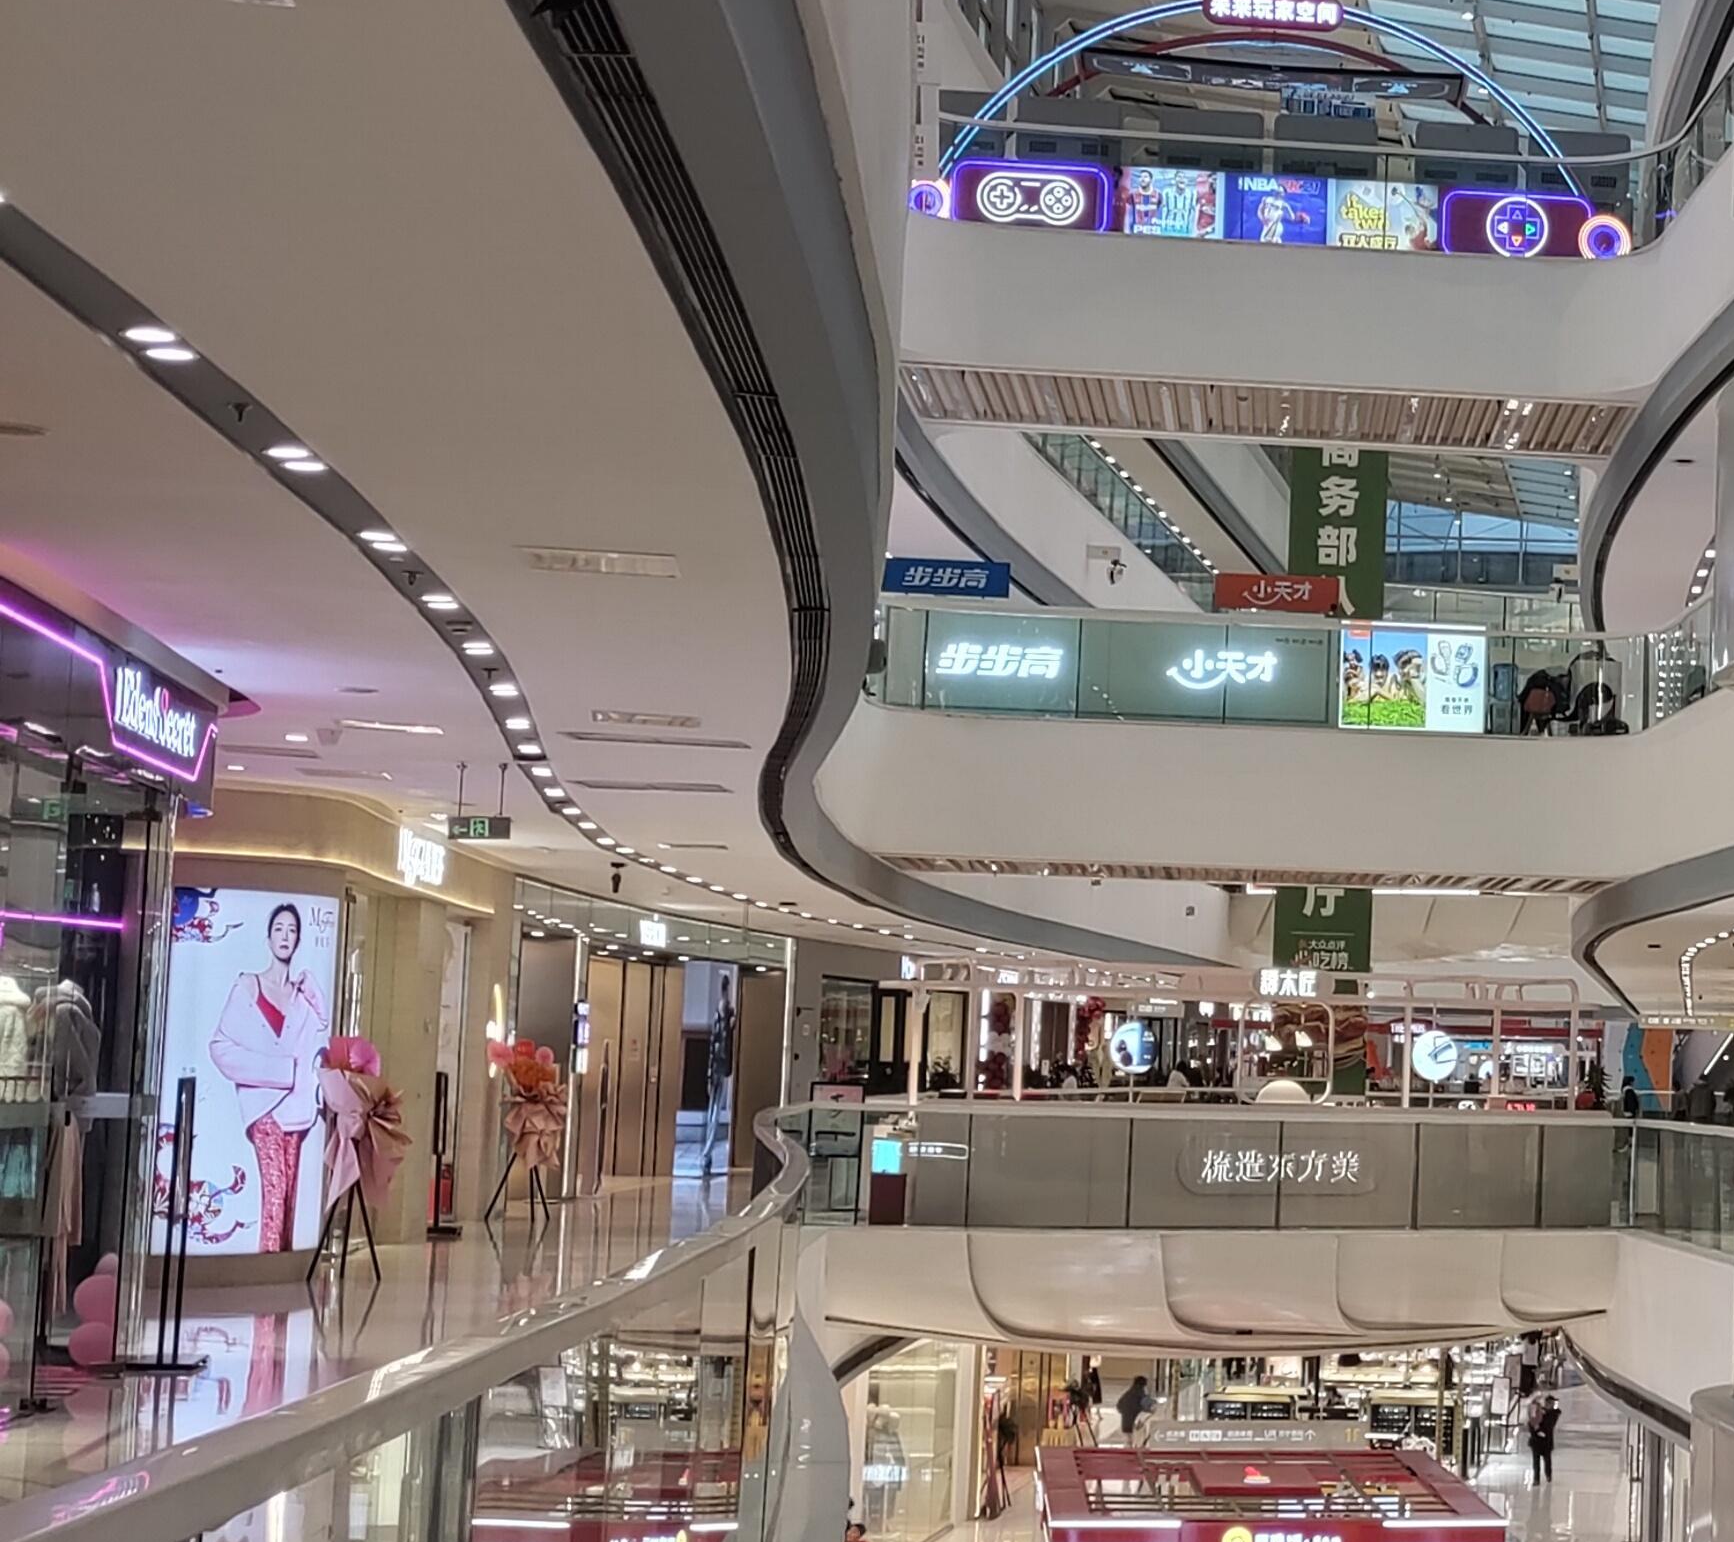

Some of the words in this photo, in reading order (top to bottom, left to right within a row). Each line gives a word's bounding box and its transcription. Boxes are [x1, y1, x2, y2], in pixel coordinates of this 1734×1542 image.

[1244, 177, 1278, 191] NBA
[902, 566, 990, 588] 步步高
[1242, 580, 1312, 605] 小天才
[935, 642, 1064, 679] 步步高
[1166, 649, 1278, 689] 小天才
